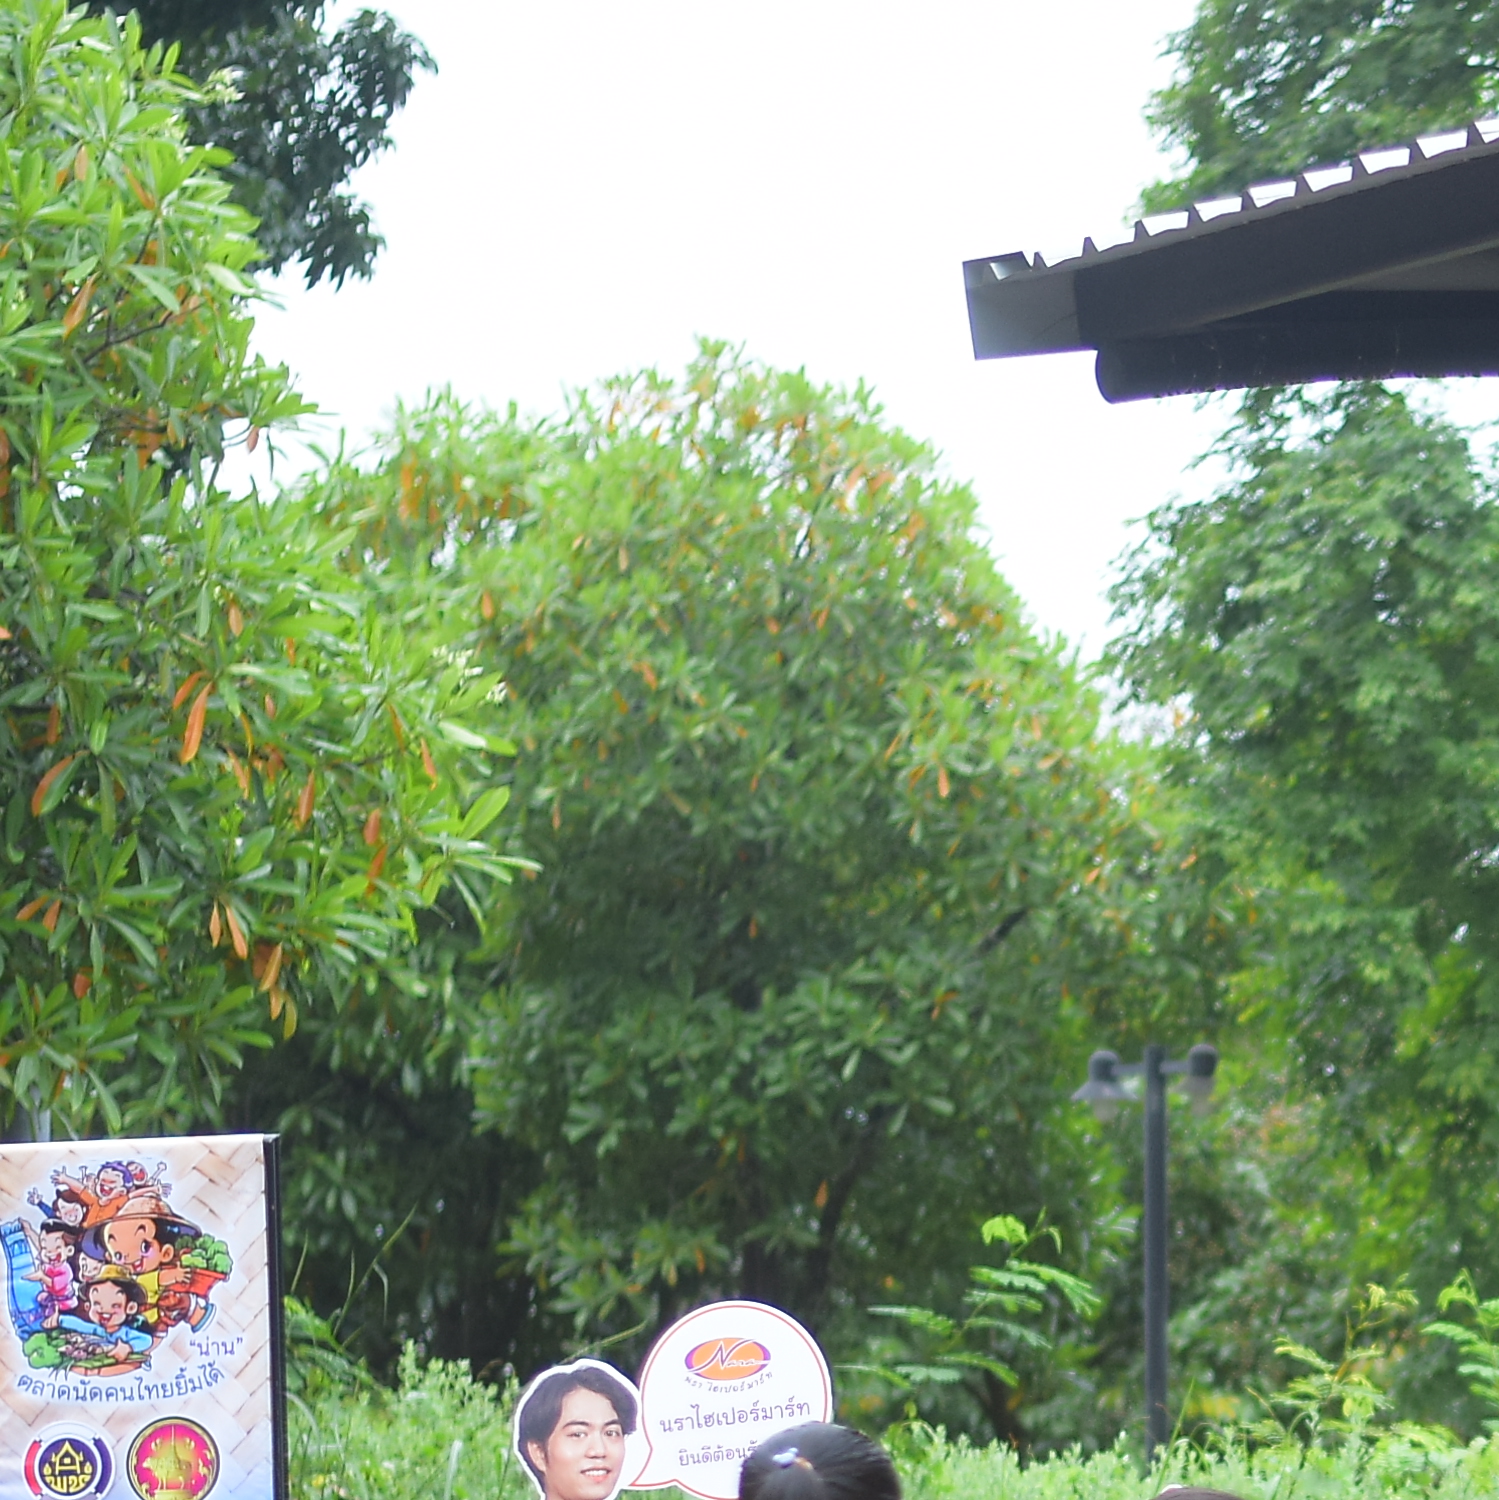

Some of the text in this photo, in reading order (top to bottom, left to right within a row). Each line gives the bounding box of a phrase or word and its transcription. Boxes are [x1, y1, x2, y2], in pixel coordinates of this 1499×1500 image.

[16, 1360, 225, 1402] ตลาดนัดคนไทยยิ้มได้
[659, 1396, 810, 1433] นราไฮเปอร์มาร์ท
